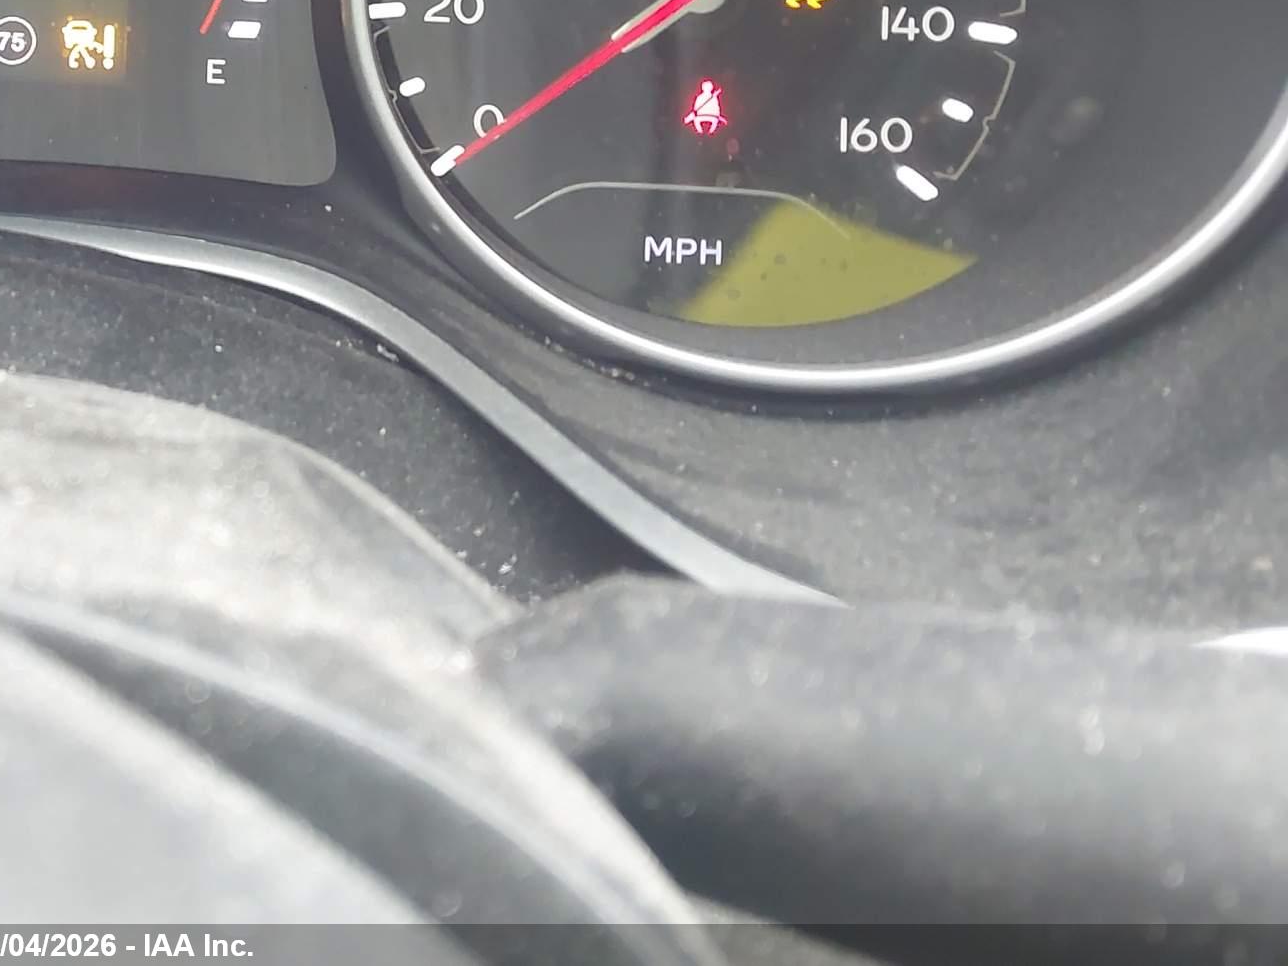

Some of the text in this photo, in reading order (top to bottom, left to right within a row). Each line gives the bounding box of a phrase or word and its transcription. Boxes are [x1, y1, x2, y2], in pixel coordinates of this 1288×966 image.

[881, 6, 955, 42] 140
[206, 58, 226, 85] E
[839, 117, 913, 153] 160
[644, 236, 722, 266] MPH
